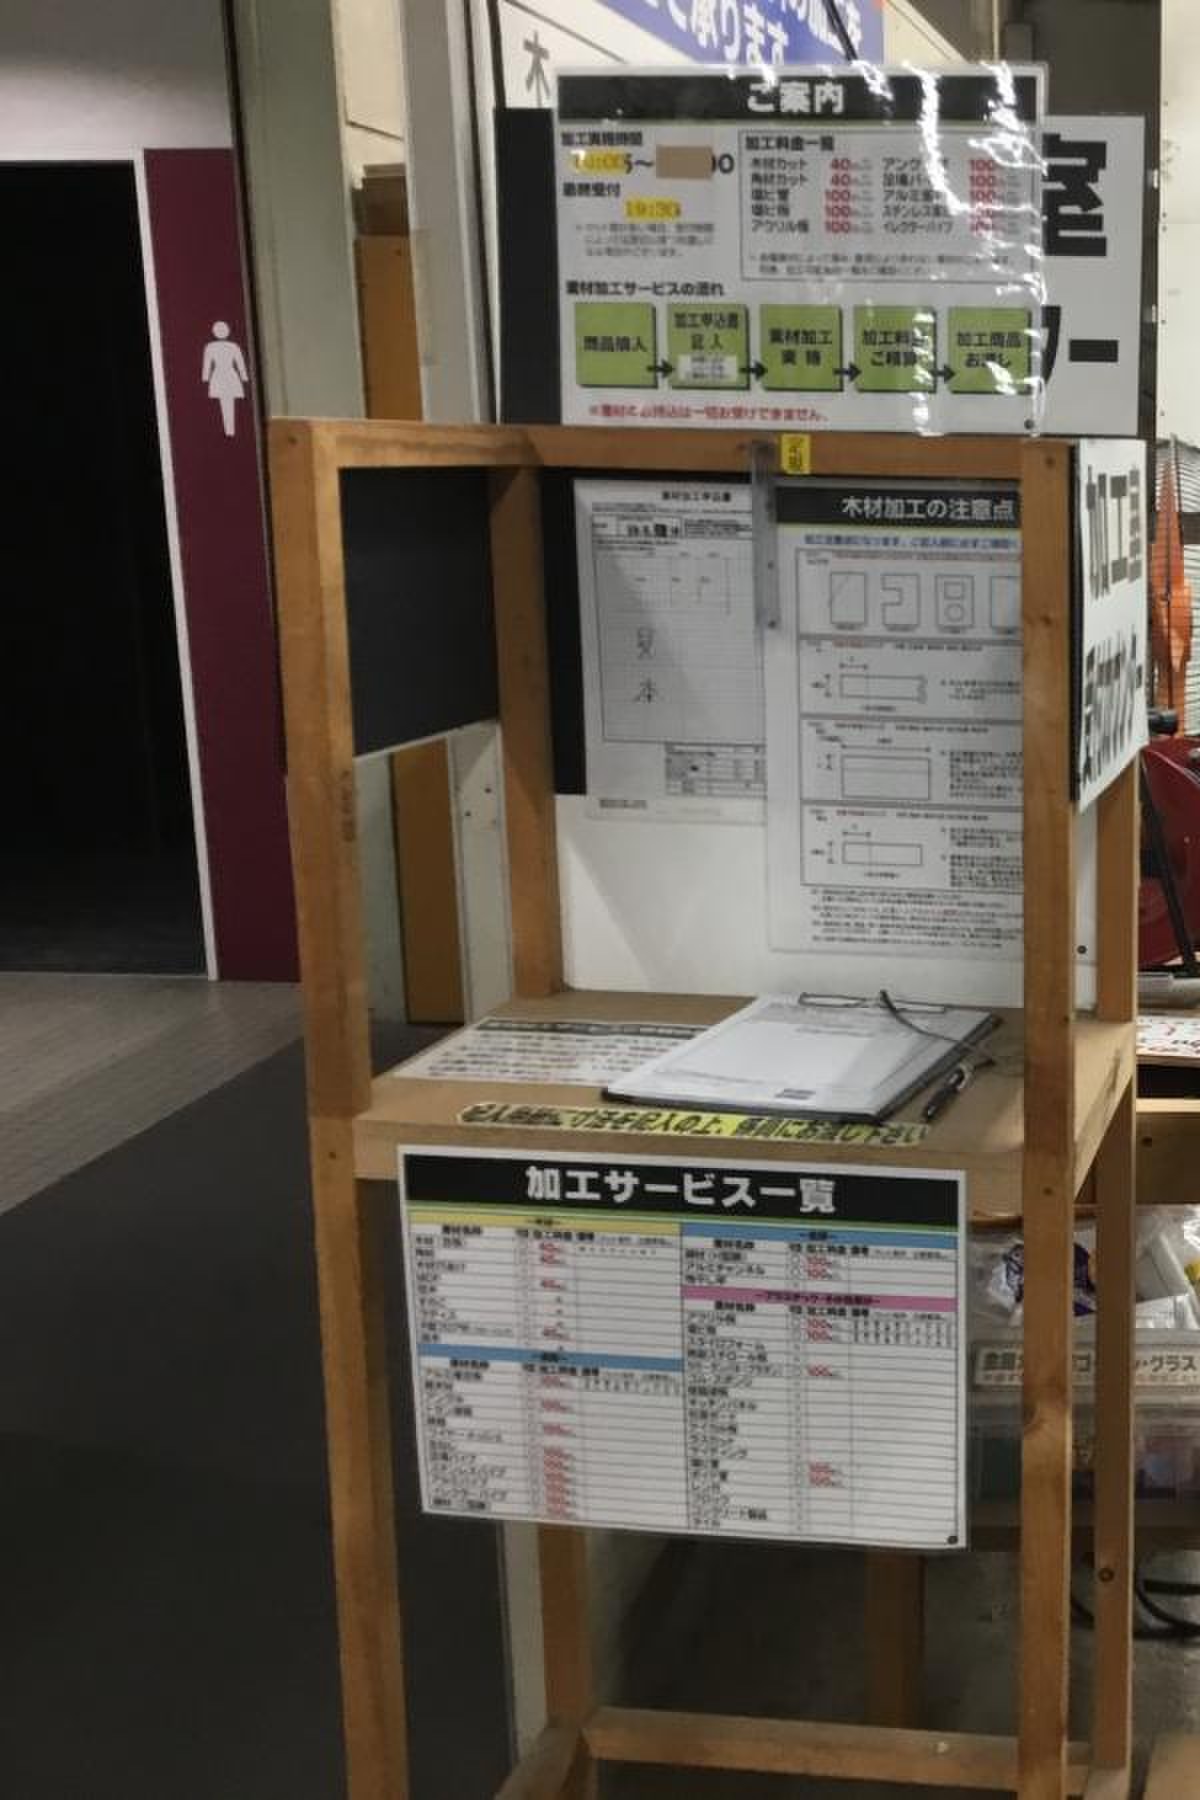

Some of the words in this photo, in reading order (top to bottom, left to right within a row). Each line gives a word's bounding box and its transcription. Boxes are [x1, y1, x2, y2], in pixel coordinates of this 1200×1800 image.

[746, 82, 845, 114] ご案内
[842, 496, 1015, 520] 木材加工の注意点
[526, 1165, 836, 1214] 加工サービス一覧
